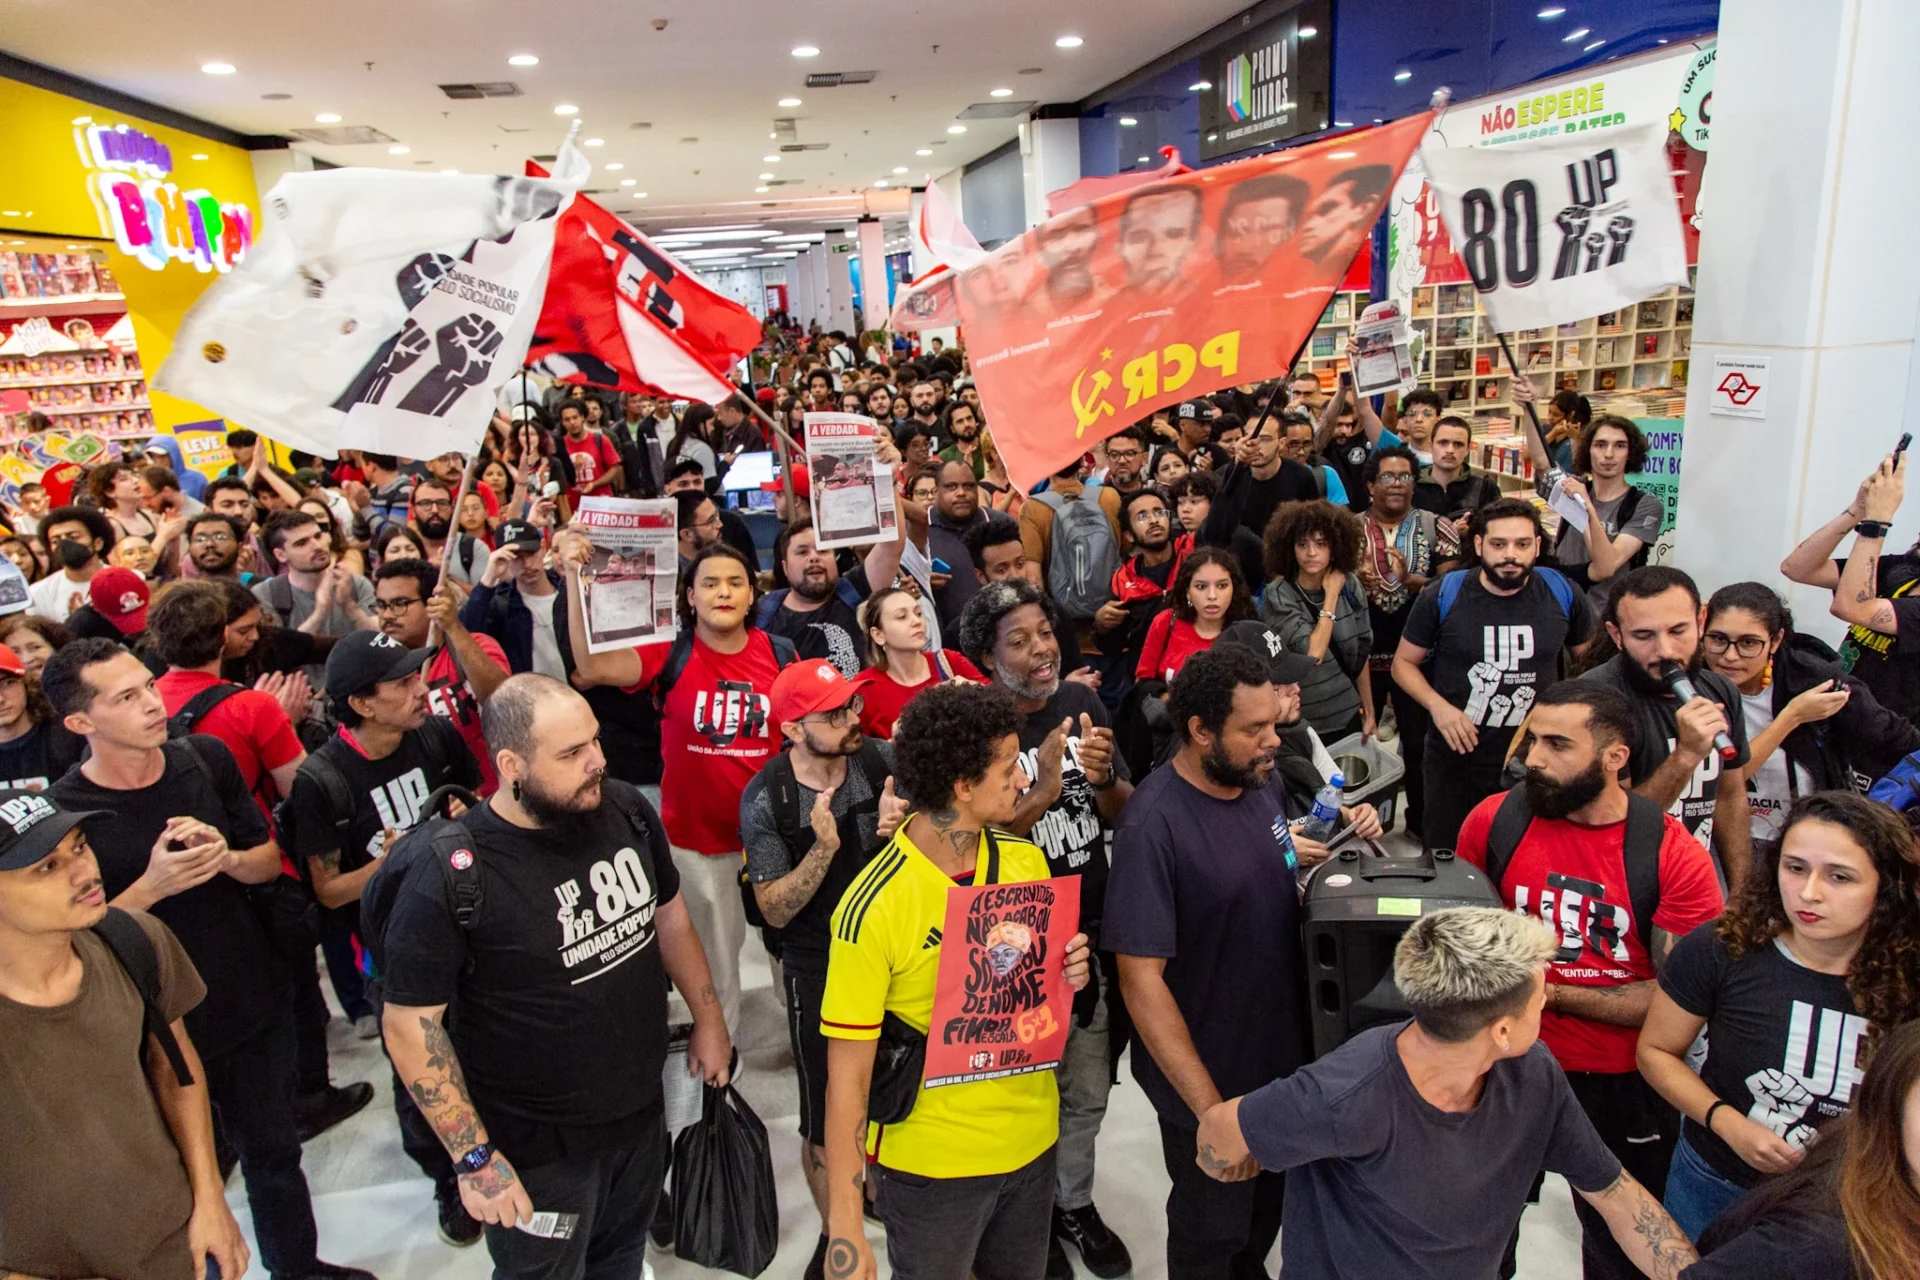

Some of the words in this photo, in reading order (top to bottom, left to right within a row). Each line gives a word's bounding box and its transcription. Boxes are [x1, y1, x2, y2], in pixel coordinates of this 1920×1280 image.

[1252, 39, 1287, 85] PROMO
[1252, 77, 1288, 121] LIVROS
[1683, 70, 1698, 94] UM
[1481, 105, 1516, 135] NÃO
[1516, 82, 1605, 128] ESPERE
[1564, 148, 1618, 208] UP
[1461, 178, 1539, 294] 80
[457, 285, 517, 316] SOCIALISMO
[477, 279, 520, 303] POPULAR
[183, 436, 221, 454] LEVE
[811, 425, 818, 436] A
[820, 424, 859, 436] VERDADE
[582, 513, 590, 524] A
[591, 513, 639, 528] VERDADE
[1483, 625, 1535, 672] UP
[369, 766, 431, 830] UP
[553, 878, 582, 909] UP
[589, 846, 652, 924] 80
[968, 891, 985, 914] A
[984, 884, 1055, 911] ESCRAVIDÃO
[966, 913, 999, 948] NÃO
[1003, 904, 1052, 935] ACABOU
[561, 926, 617, 968] UNIDADE
[600, 950, 616, 964] PELO
[614, 930, 646, 955] SOCIALISMO
[962, 991, 987, 1015] DE
[988, 968, 1048, 1016] NOME
[981, 1030, 1018, 1045] ESCALA
[999, 1050, 1016, 1067] UP
